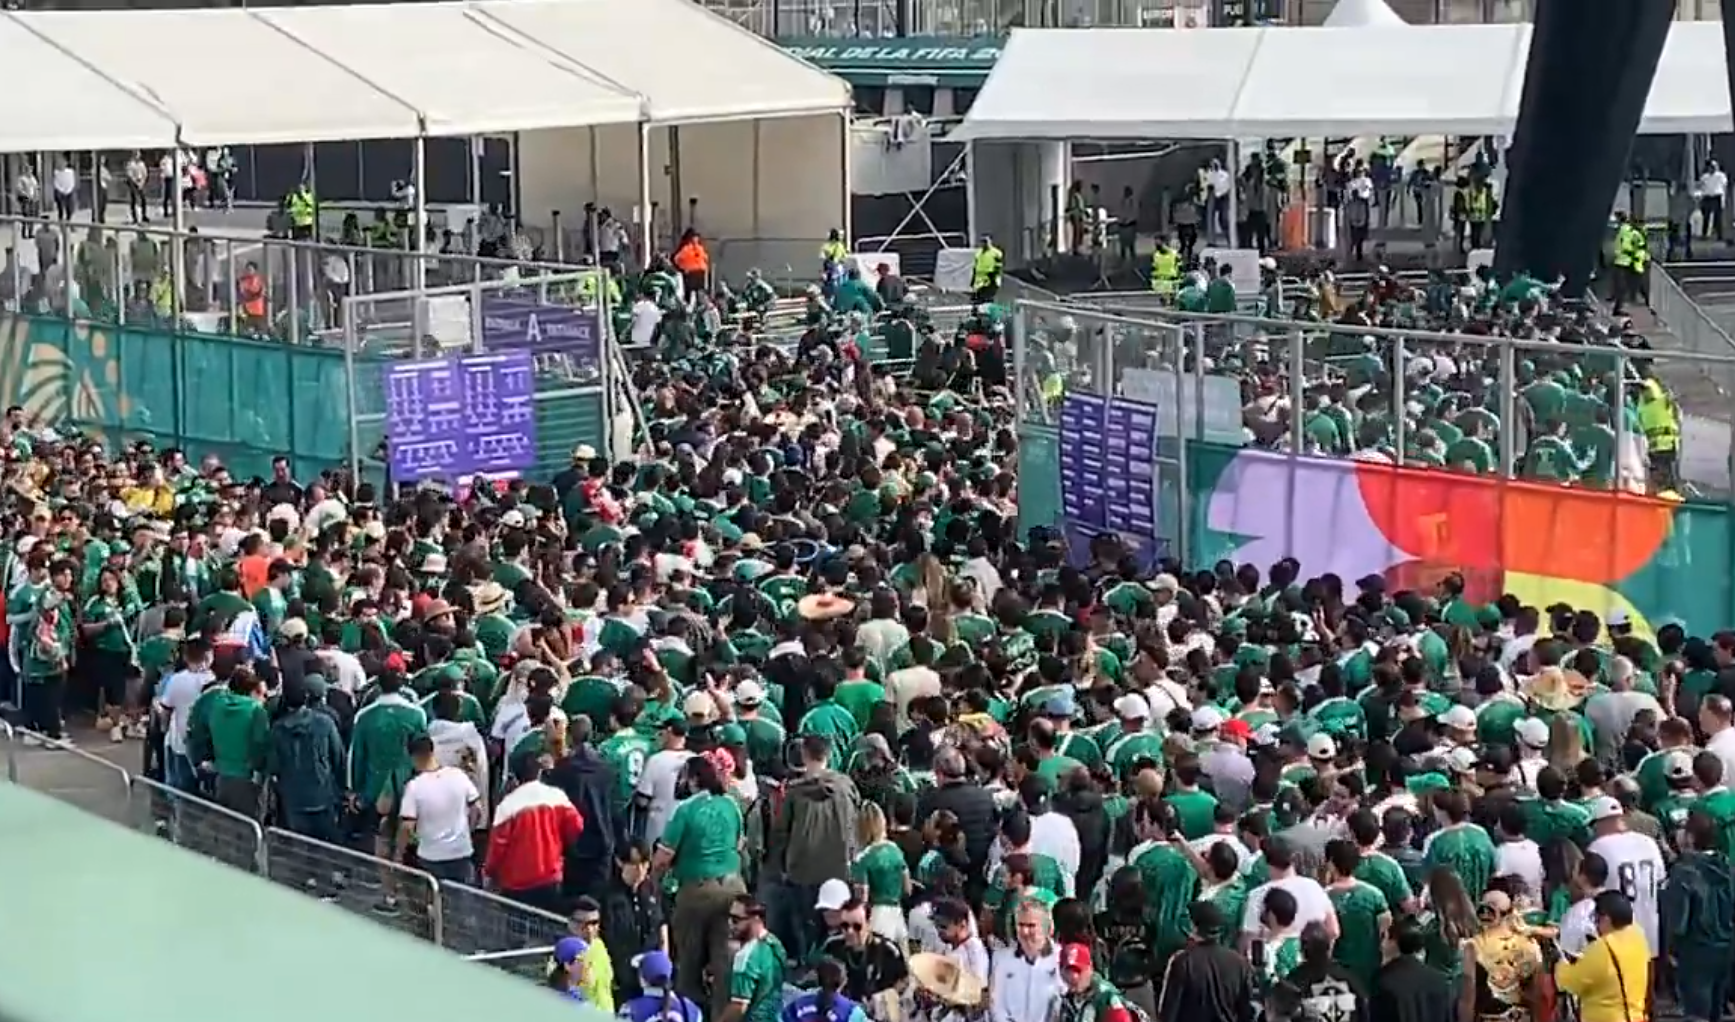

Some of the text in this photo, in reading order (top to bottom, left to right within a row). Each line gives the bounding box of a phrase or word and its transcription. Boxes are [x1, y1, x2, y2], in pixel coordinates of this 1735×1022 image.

[840, 47, 873, 58] DE
[876, 48, 910, 59] LA
[911, 48, 967, 60] FIFA
[526, 312, 542, 341] A
